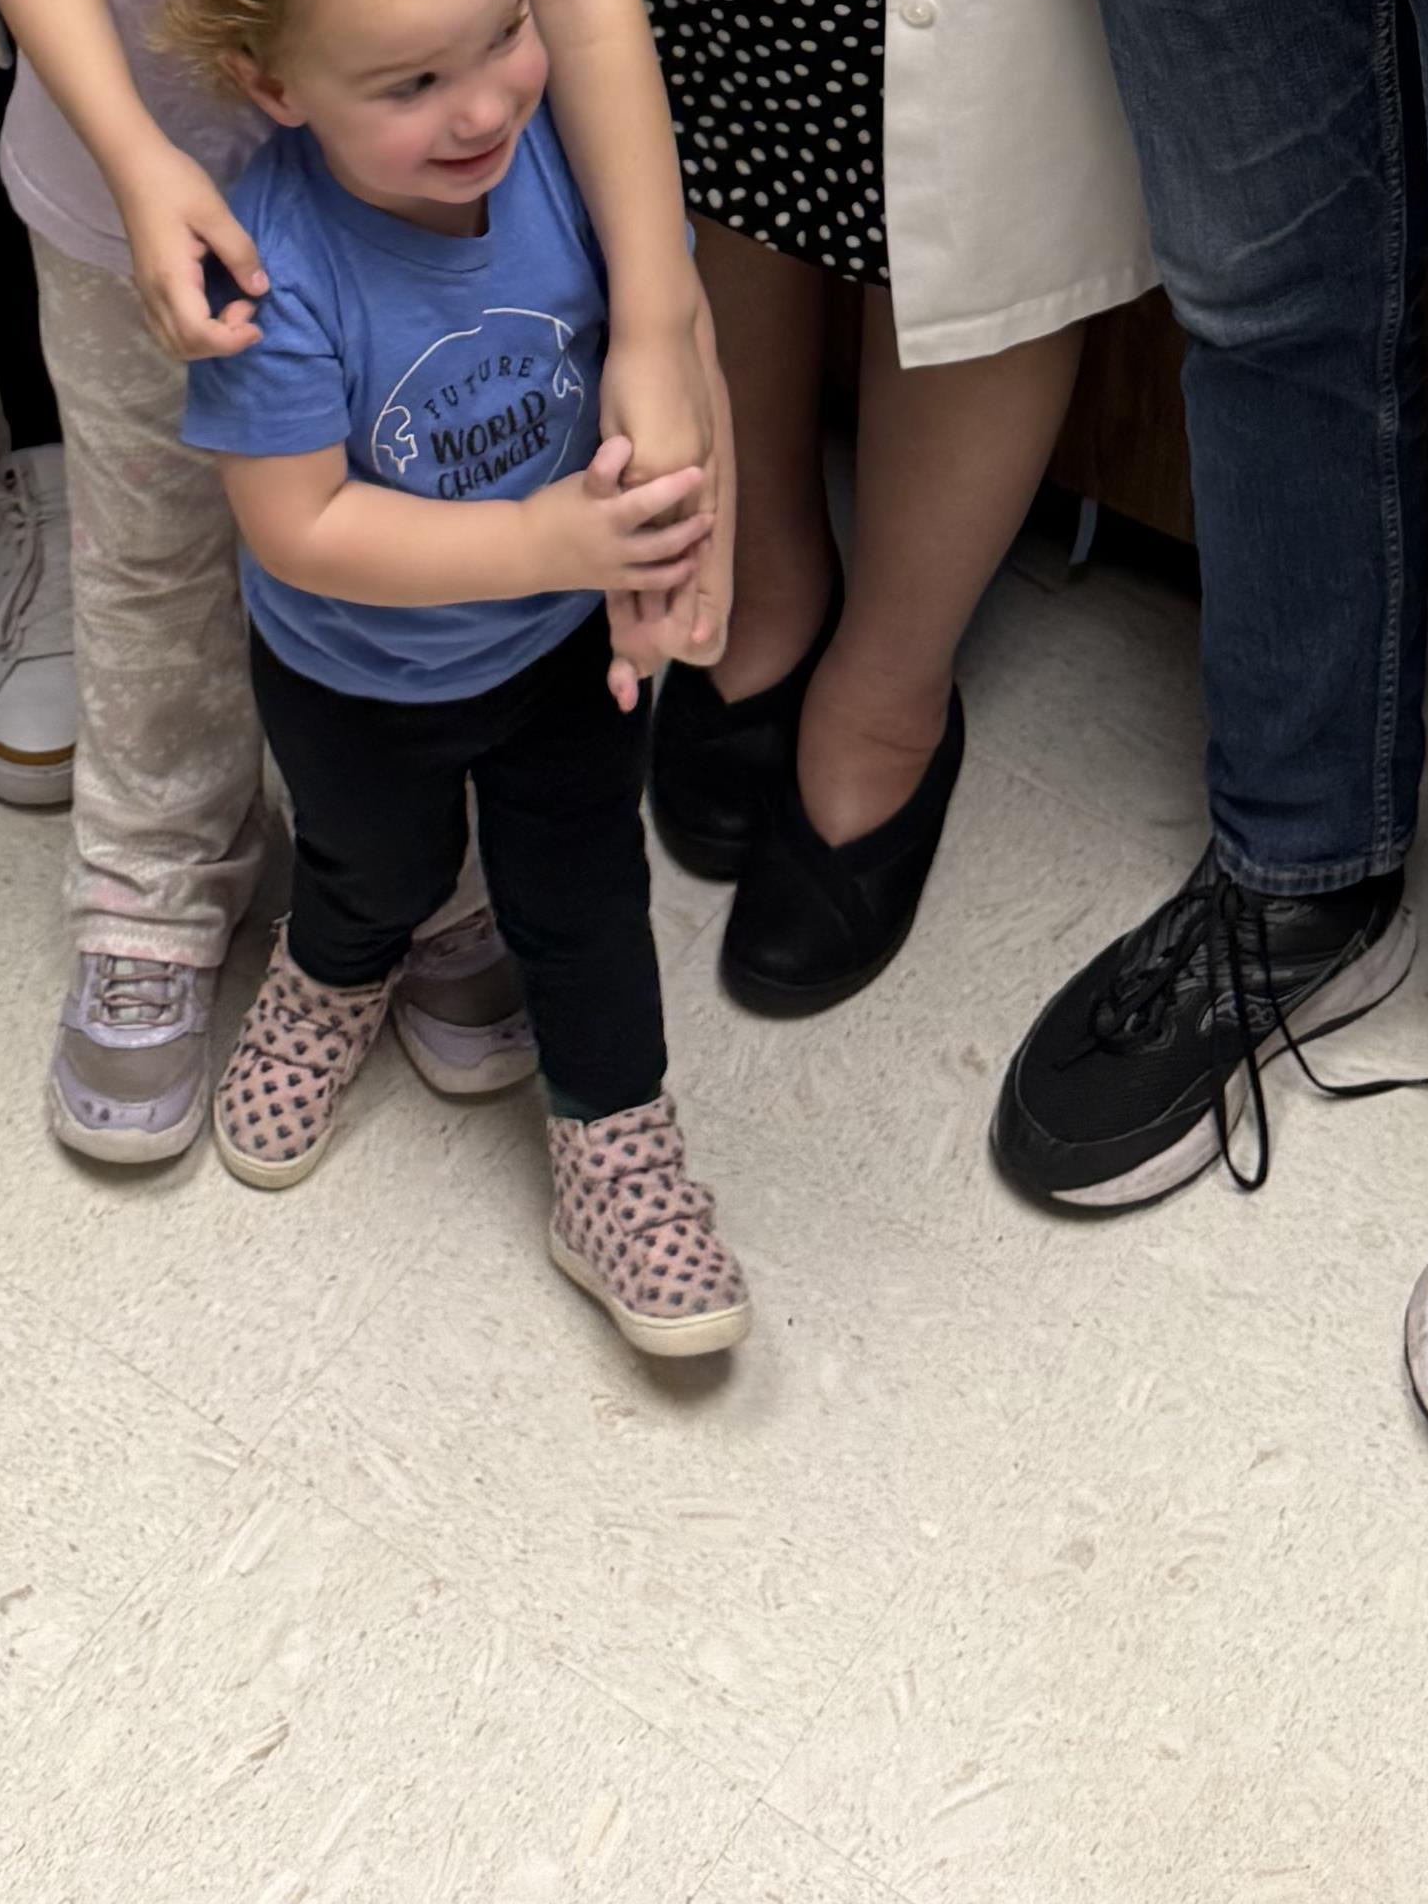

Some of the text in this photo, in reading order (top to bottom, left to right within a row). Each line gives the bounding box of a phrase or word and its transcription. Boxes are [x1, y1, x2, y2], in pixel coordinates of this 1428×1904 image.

[424, 356, 533, 418] FUTURE
[431, 391, 546, 464] WORLD
[438, 424, 549, 501] CHANGER
